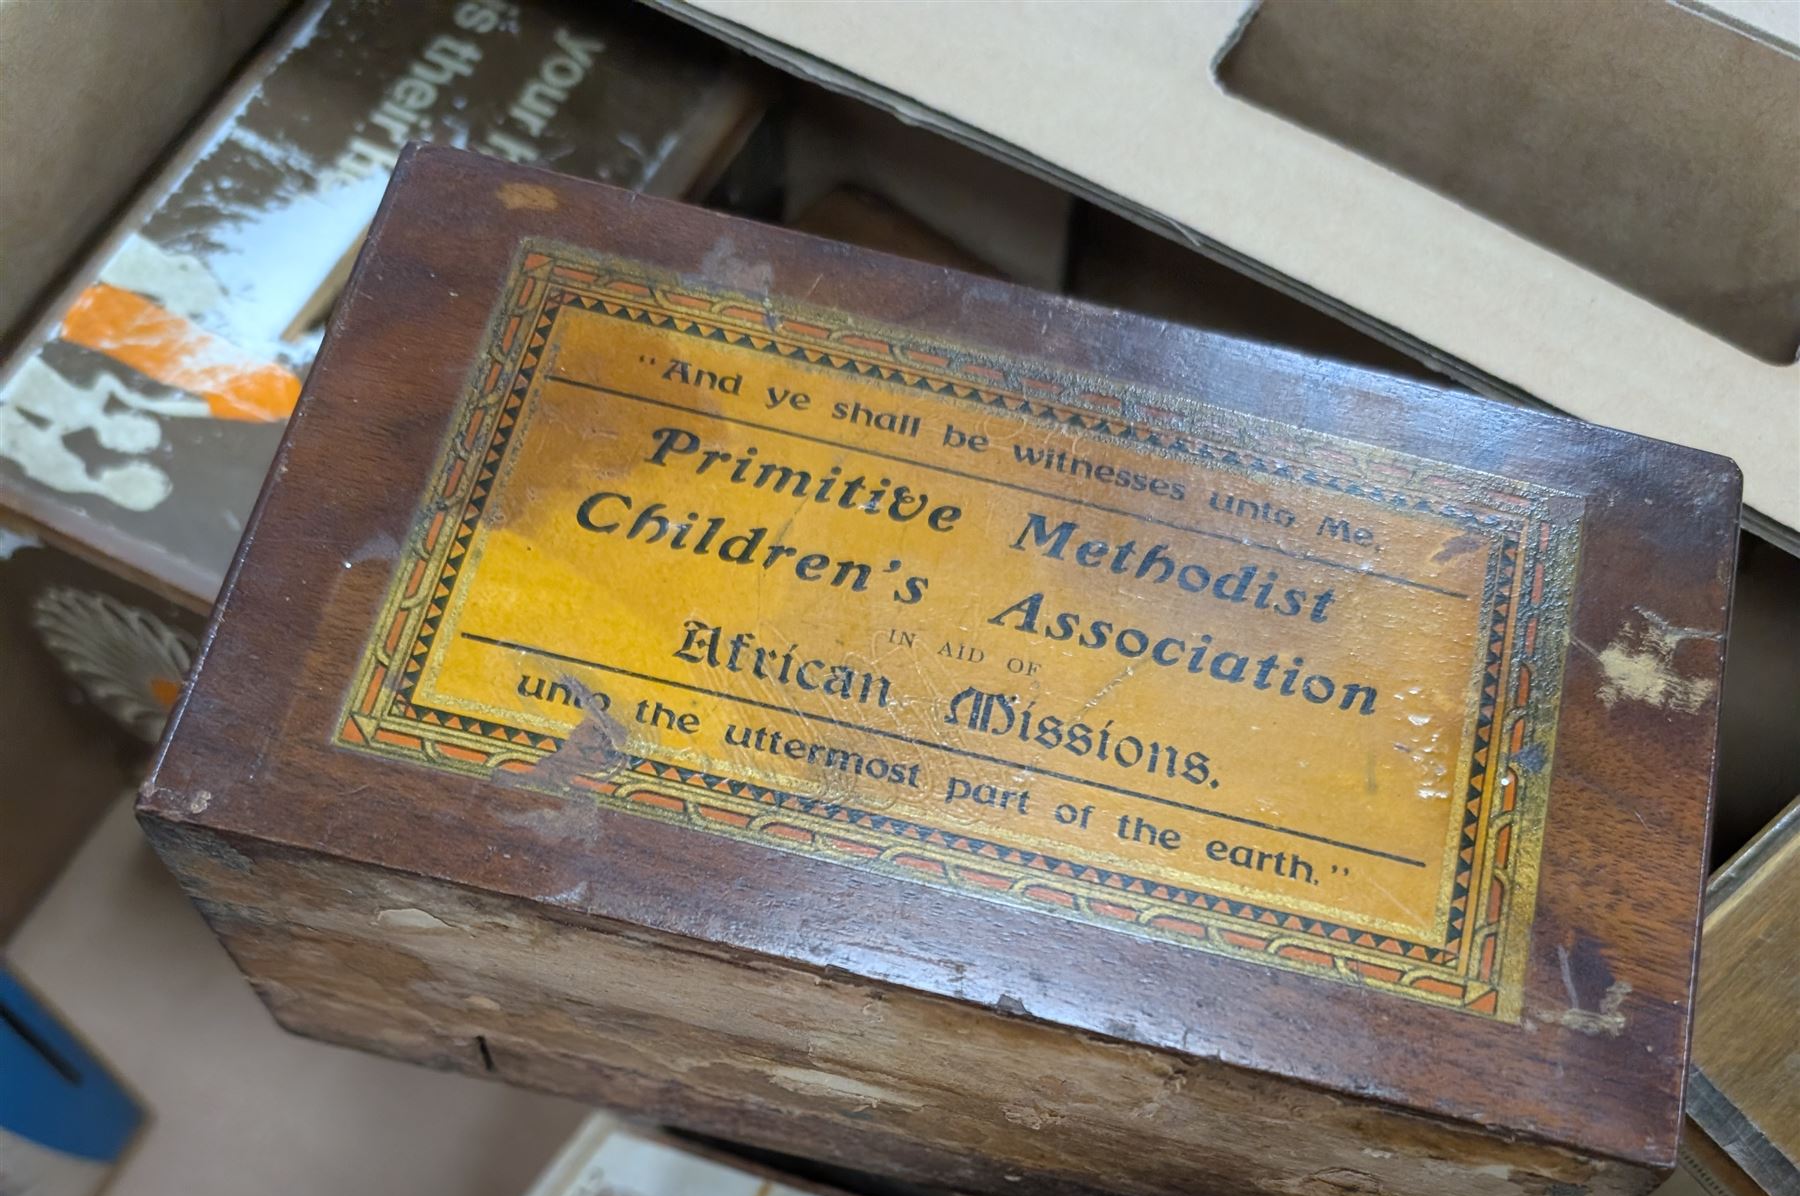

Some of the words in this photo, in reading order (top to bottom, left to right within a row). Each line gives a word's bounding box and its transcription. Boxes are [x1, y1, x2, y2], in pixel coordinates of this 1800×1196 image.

[369, 33, 484, 145] their
[507, 27, 606, 138] your
[638, 354, 743, 396] "And
[765, 383, 812, 411] ye
[831, 400, 922, 438] shall
[942, 423, 990, 453] be
[1012, 443, 1187, 501] witnesses
[1208, 490, 1297, 529] unto
[643, 426, 965, 533] Primitive
[1008, 511, 1338, 624] Methodist
[574, 491, 930, 605] Children's
[986, 591, 1380, 717] Association
[888, 628, 918, 650] IN
[936, 641, 986, 665] AID
[1006, 656, 1043, 678] OF
[516, 674, 612, 713] uno
[635, 698, 701, 734] the
[723, 723, 921, 790] uttermost
[944, 775, 1031, 816] part
[1054, 798, 1096, 831] of
[1117, 812, 1182, 850] the
[671, 619, 893, 709] African
[944, 685, 1221, 790] Missions.
